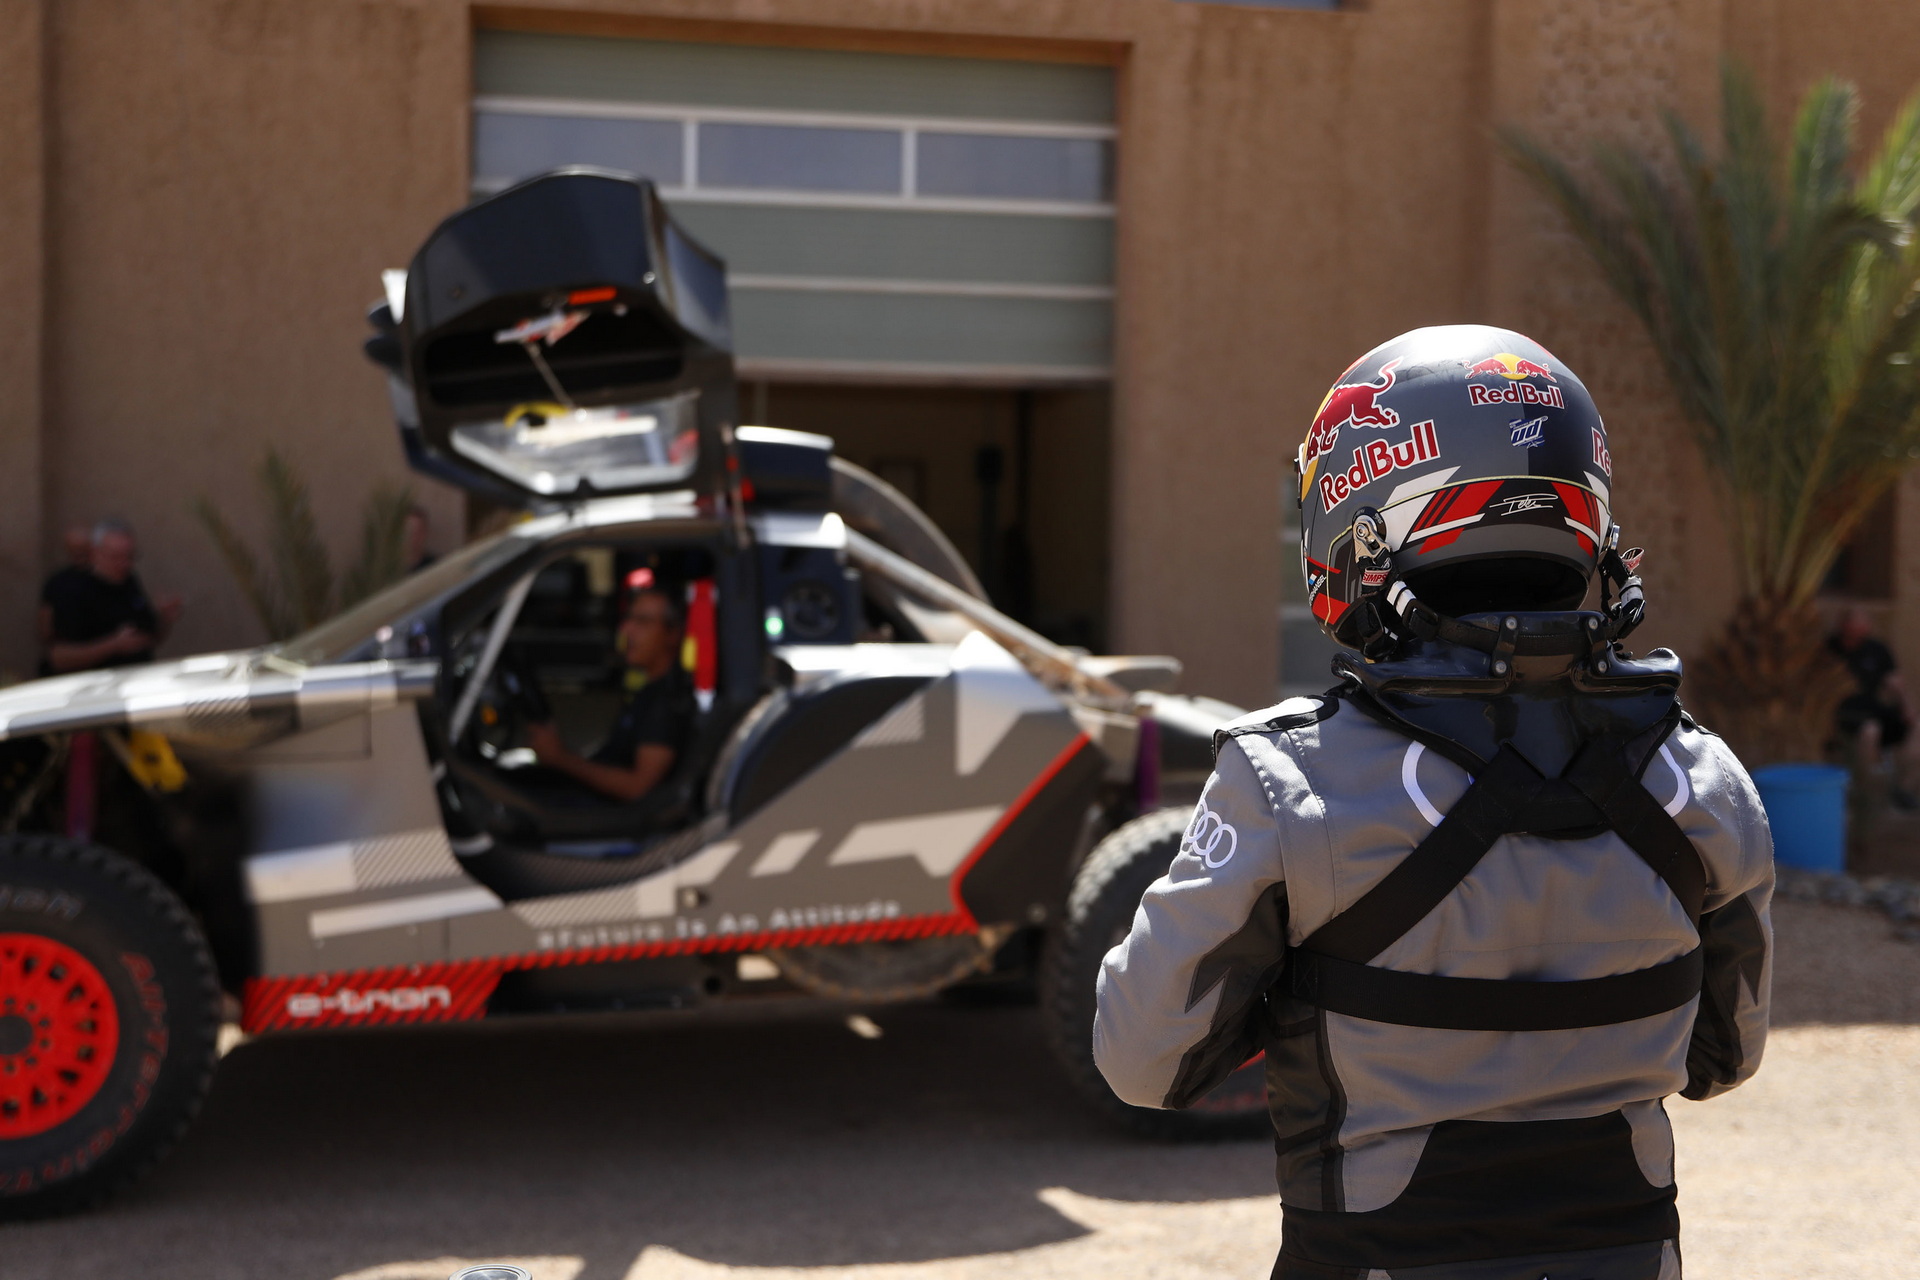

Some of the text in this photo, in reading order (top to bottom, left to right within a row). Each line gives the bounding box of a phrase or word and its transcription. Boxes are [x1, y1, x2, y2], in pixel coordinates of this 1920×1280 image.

[1467, 381, 1564, 409] Red Bull
[1319, 419, 1440, 514] Red Bull
[1361, 571, 1388, 584] SIMPS
[718, 912, 759, 935] An
[769, 900, 901, 930] Attitude
[287, 985, 451, 1017] e-tron
